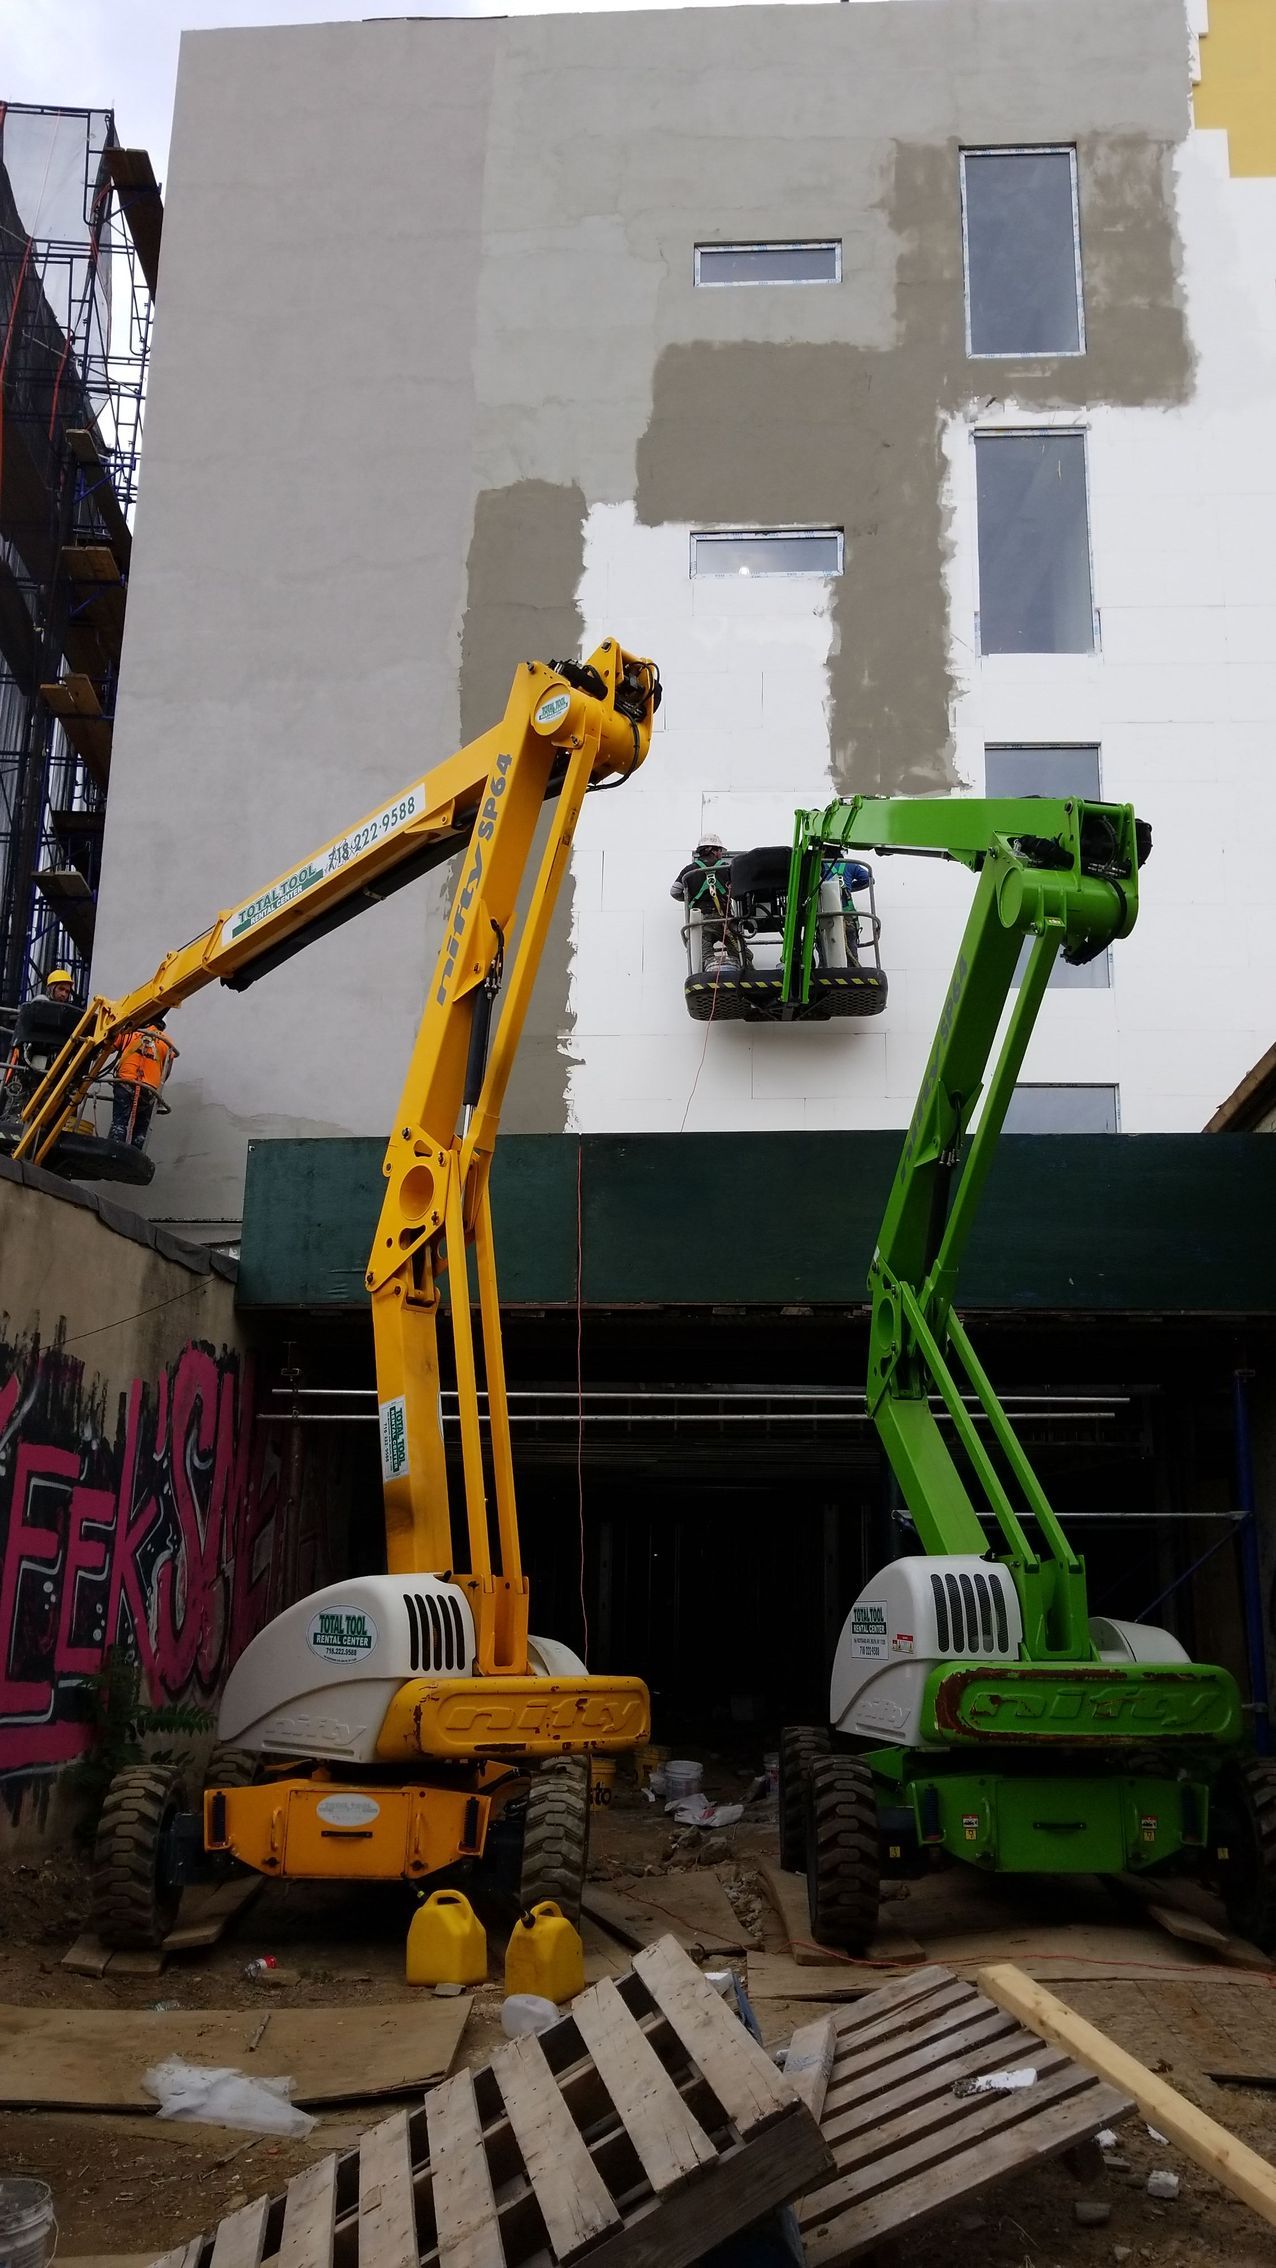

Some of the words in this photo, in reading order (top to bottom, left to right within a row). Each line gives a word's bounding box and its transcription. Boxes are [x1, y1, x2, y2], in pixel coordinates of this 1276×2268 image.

[478, 753, 512, 842] SP64
[238, 889, 280, 925] TOTAL
[280, 864, 317, 896] TOOL
[250, 902, 277, 925] RENTAL
[276, 885, 304, 909] CENTER
[395, 1408, 404, 1439] TOTAL
[391, 1440, 399, 1470] CENTER
[397, 1439, 405, 1466] TOOL
[320, 1614, 345, 1634] TOTAL
[345, 1615, 368, 1635] TOOL
[853, 1606, 870, 1622] TOTAL
[870, 1606, 885, 1622] TOOL
[316, 1634, 341, 1644] RENTAL
[342, 1636, 369, 1647] CENTER
